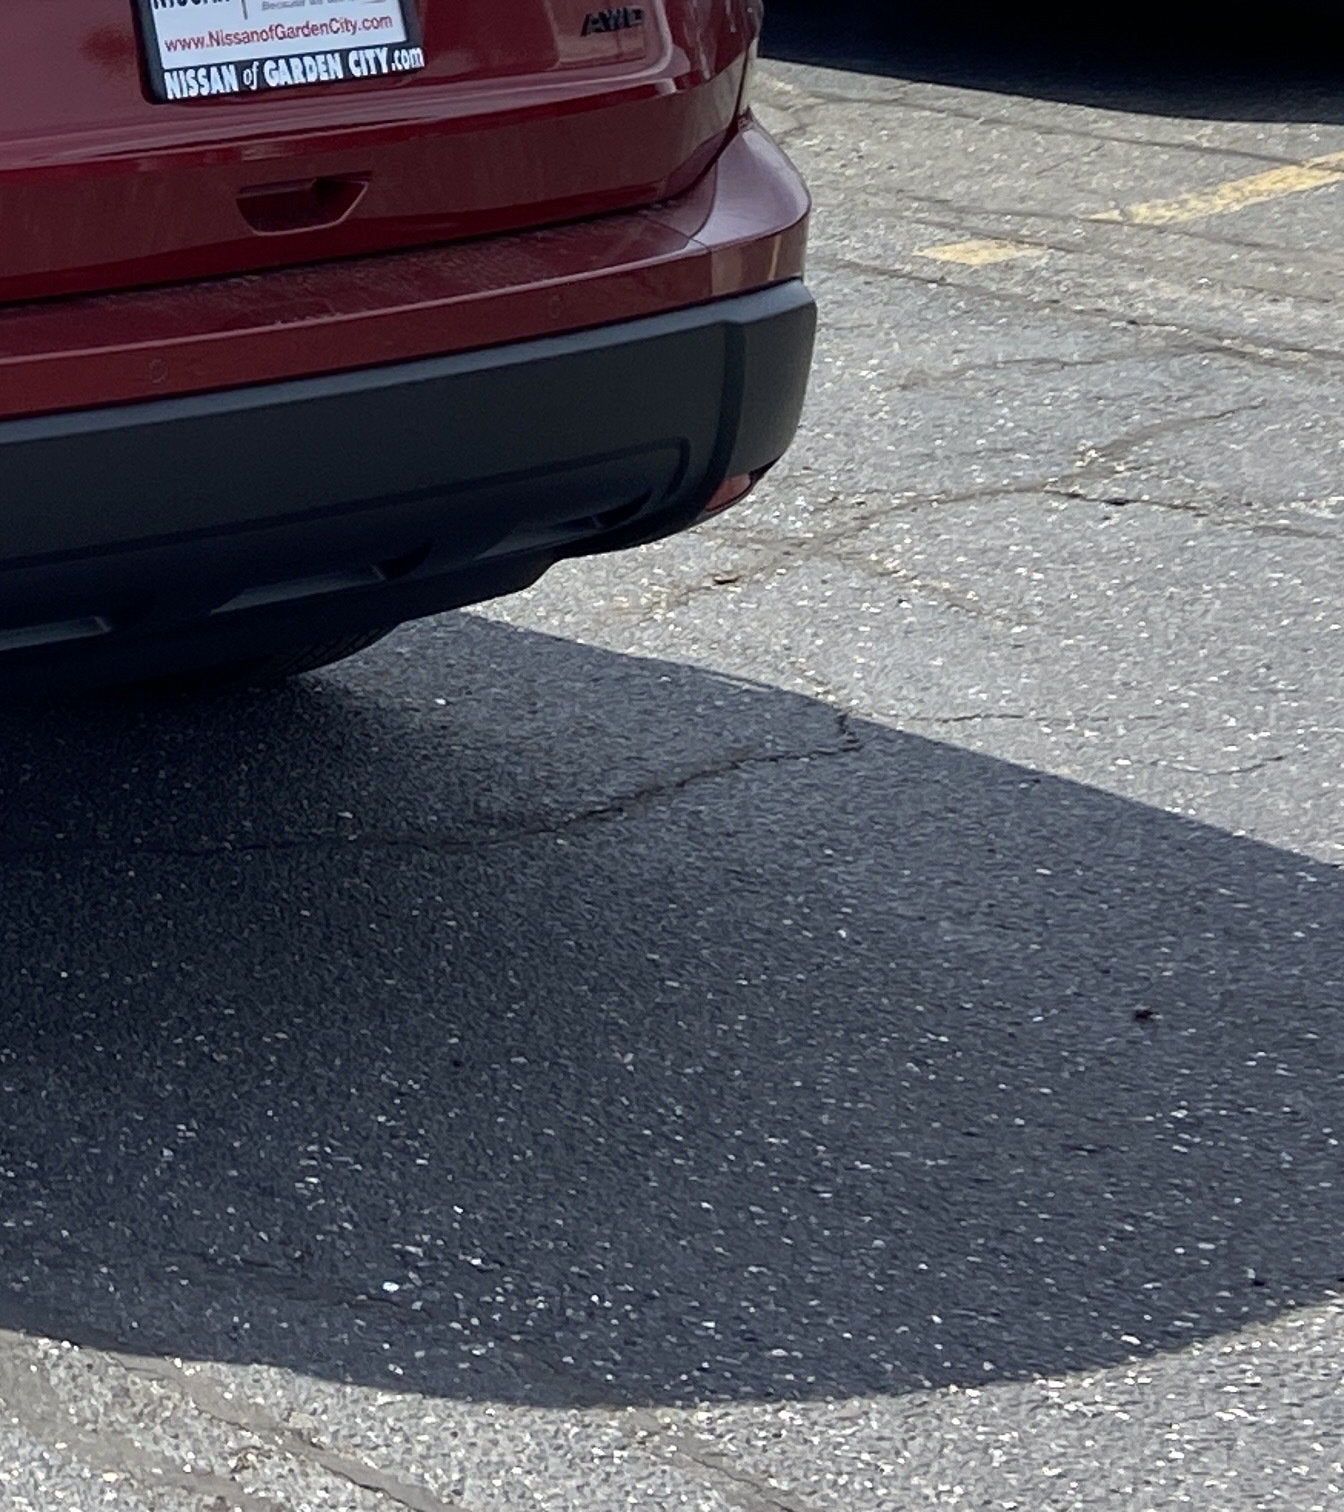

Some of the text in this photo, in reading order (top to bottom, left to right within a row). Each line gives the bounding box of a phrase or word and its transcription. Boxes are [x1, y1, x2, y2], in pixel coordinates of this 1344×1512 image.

[164, 13, 393, 53] www.NissanofGardenCity.com
[163, 46, 424, 101] NISSAN of GARDEN CITY.com
